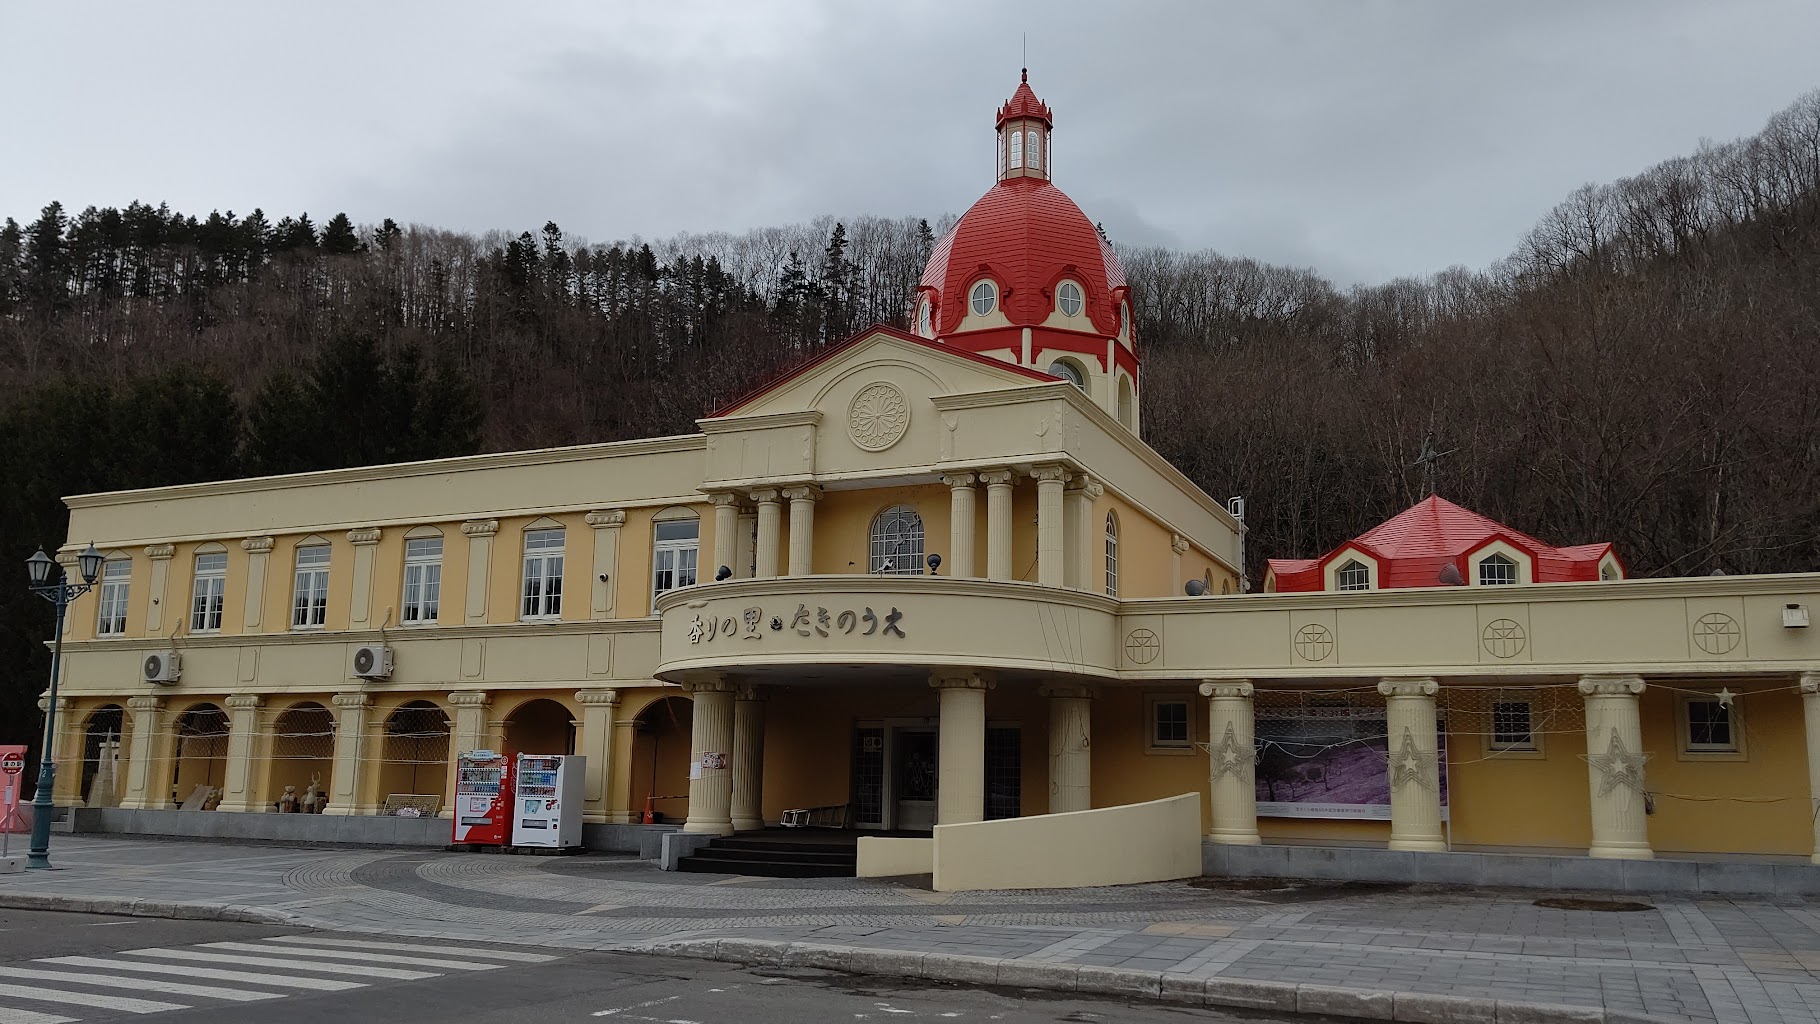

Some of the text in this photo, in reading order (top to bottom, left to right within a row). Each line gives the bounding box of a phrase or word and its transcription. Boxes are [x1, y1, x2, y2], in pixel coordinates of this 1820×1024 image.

[687, 603, 906, 644] 香りの里 たきのうえ
